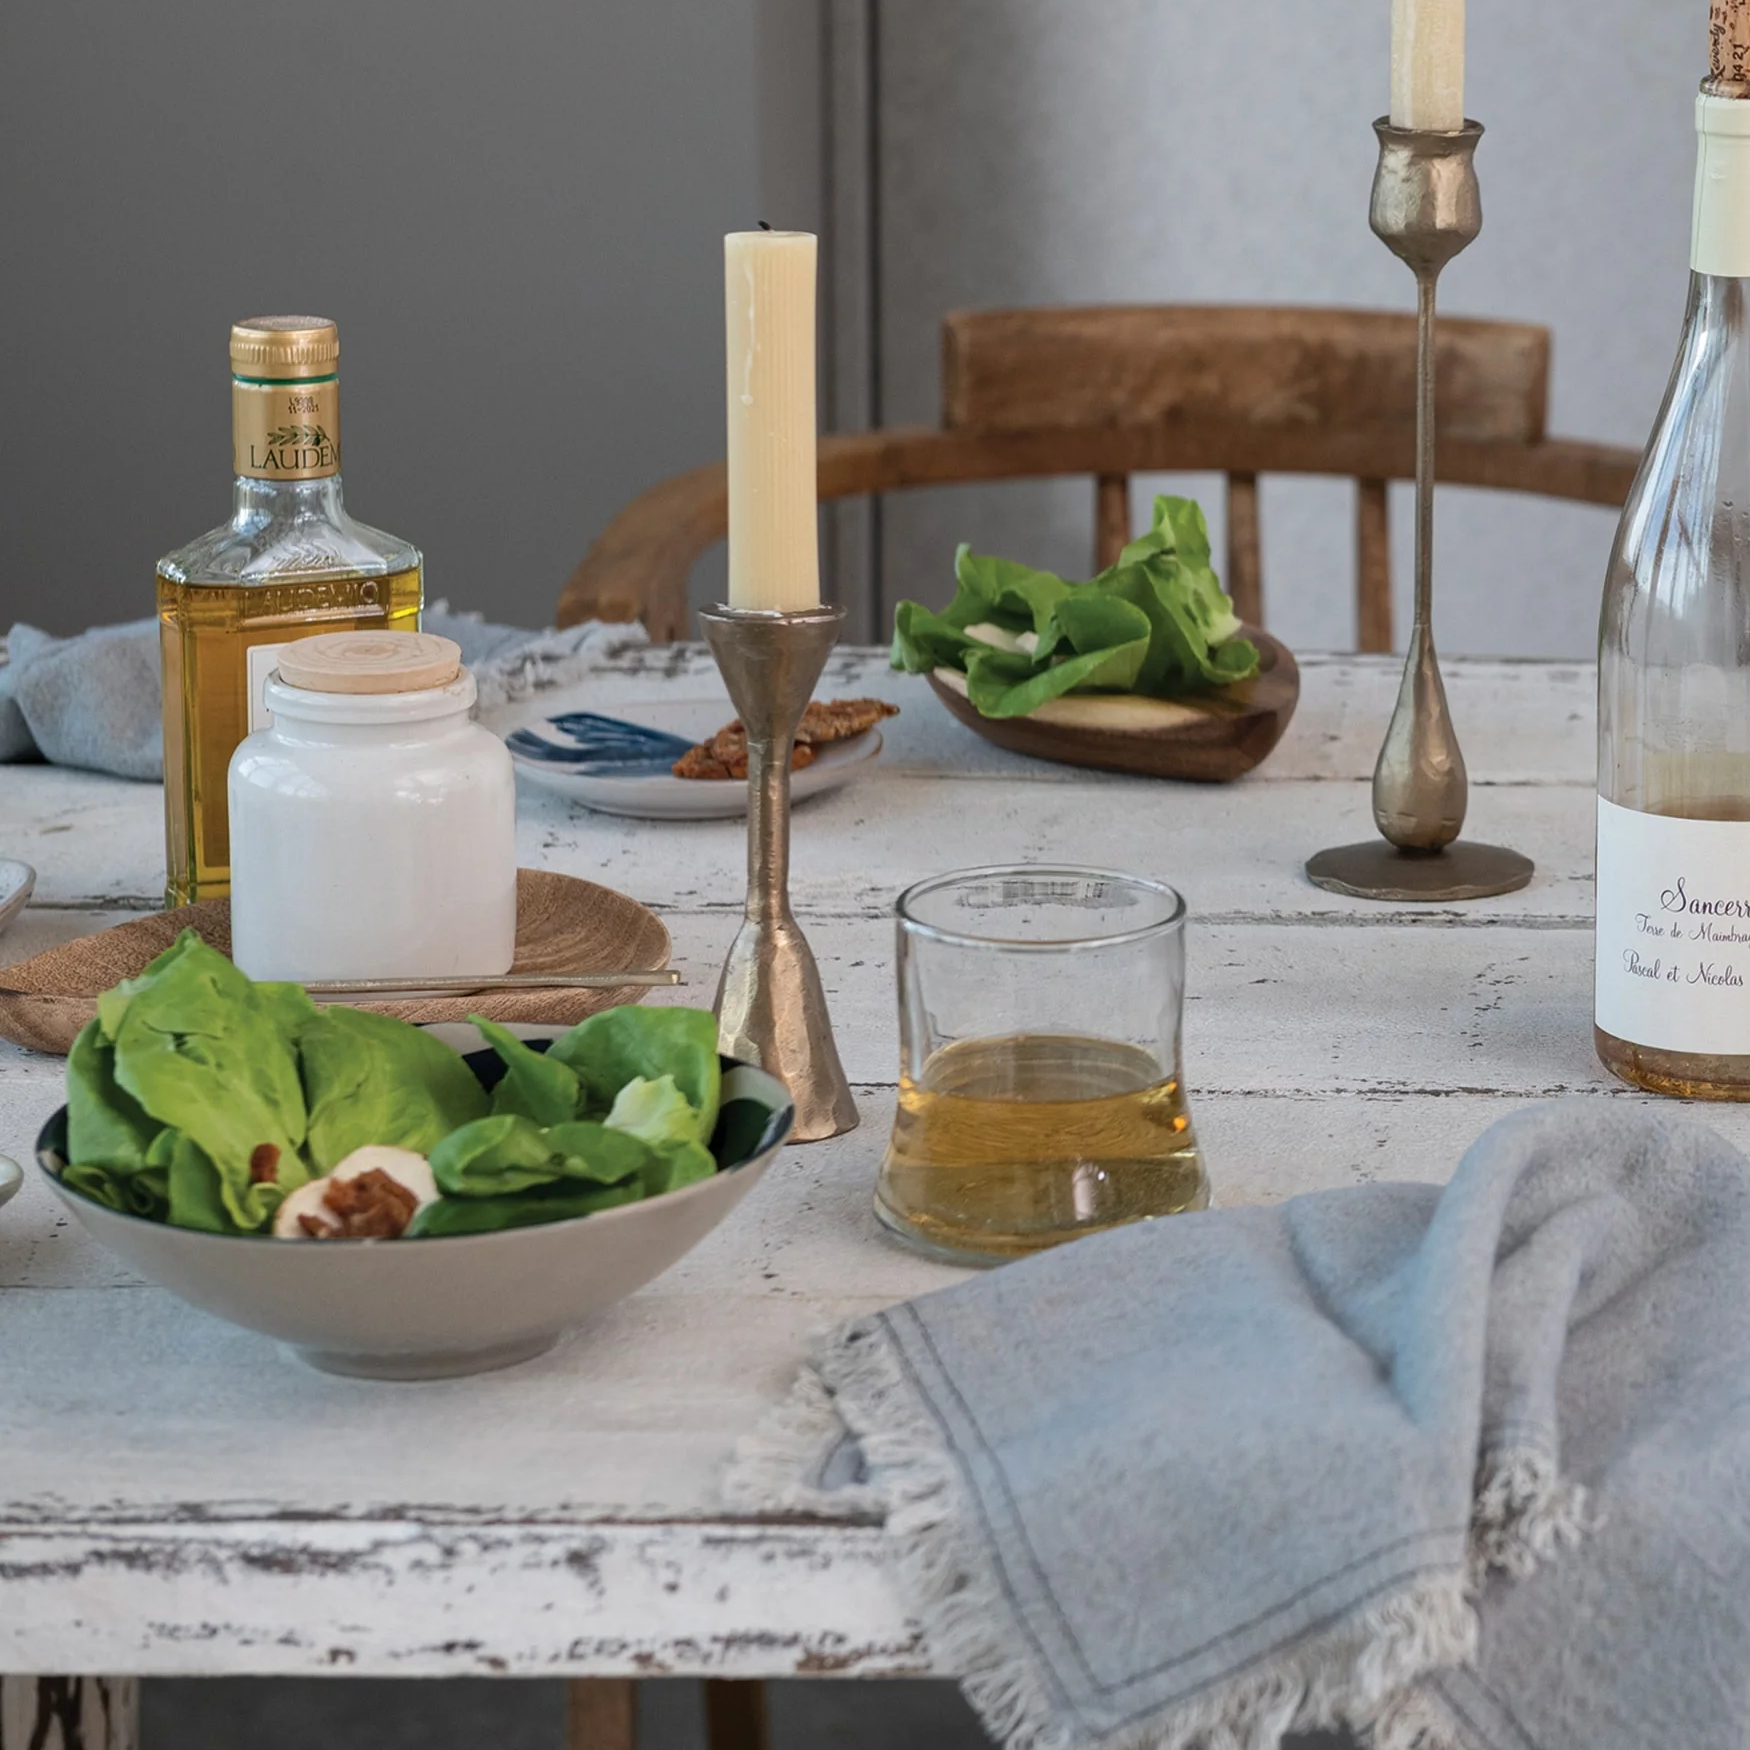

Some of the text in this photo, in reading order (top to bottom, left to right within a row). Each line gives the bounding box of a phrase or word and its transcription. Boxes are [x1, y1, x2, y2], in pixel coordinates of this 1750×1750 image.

[1635, 912, 1665, 937] Terre
[1670, 922, 1683, 939] de
[1622, 948, 1661, 980] Pascal
[1667, 964, 1680, 983] et
[1686, 961, 1744, 987] Nicolas
